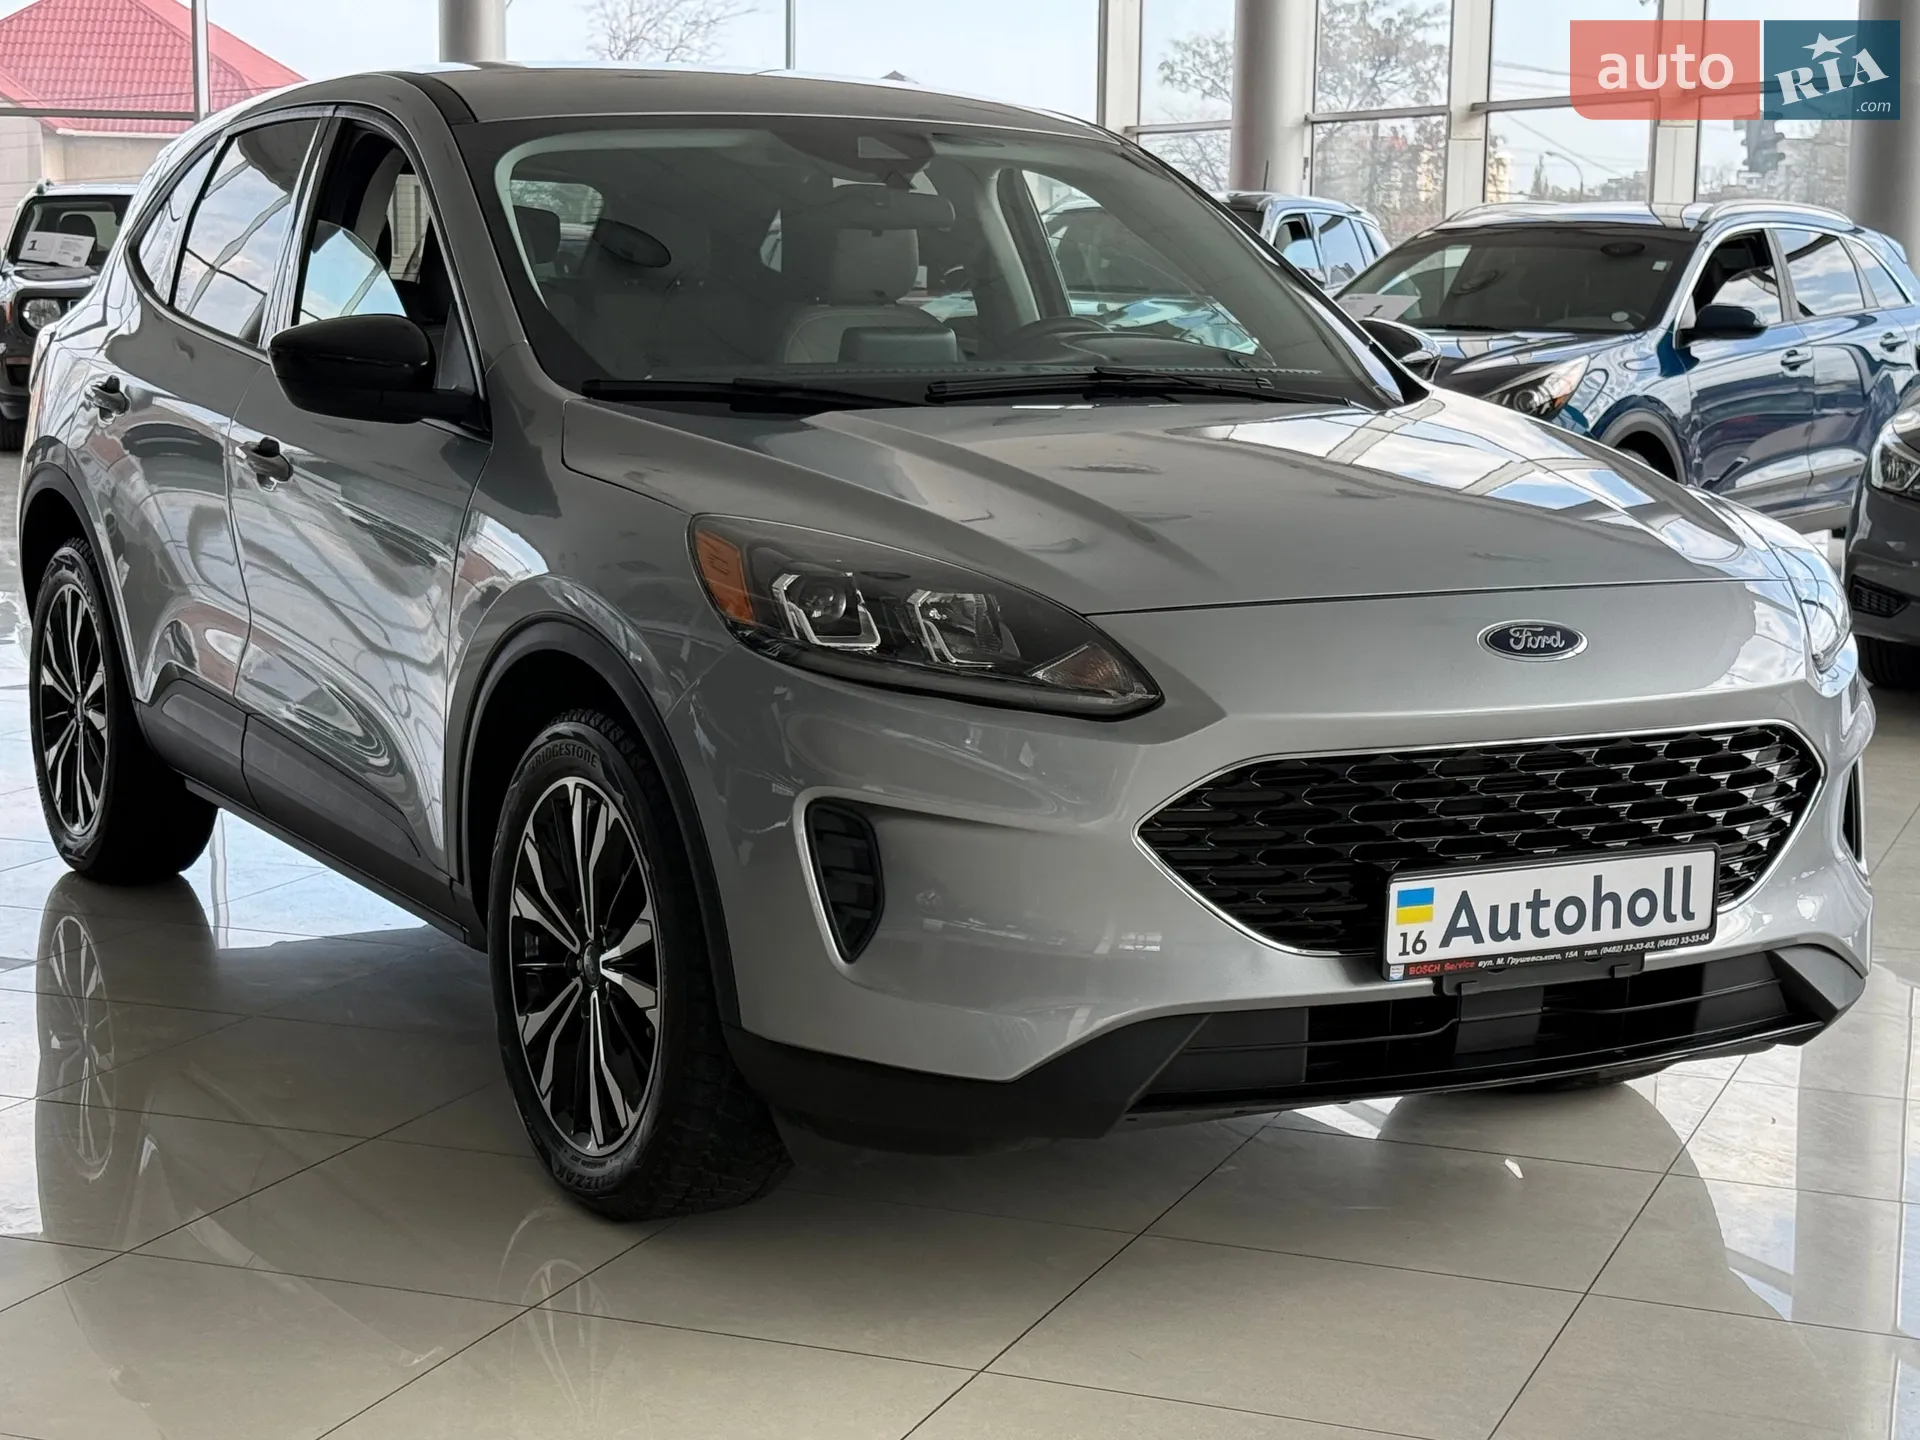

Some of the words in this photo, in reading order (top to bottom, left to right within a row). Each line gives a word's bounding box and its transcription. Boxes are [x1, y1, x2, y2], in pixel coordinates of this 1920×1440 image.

[27, 239, 38, 251] 1
[1509, 627, 1565, 650] Ford
[528, 743, 599, 773] BRIDGESTONE
[1398, 930, 1427, 957] 16
[1439, 865, 1696, 949] Autoholl
[1409, 964, 1440, 975] BOSCH
[1444, 960, 1476, 971] Service
